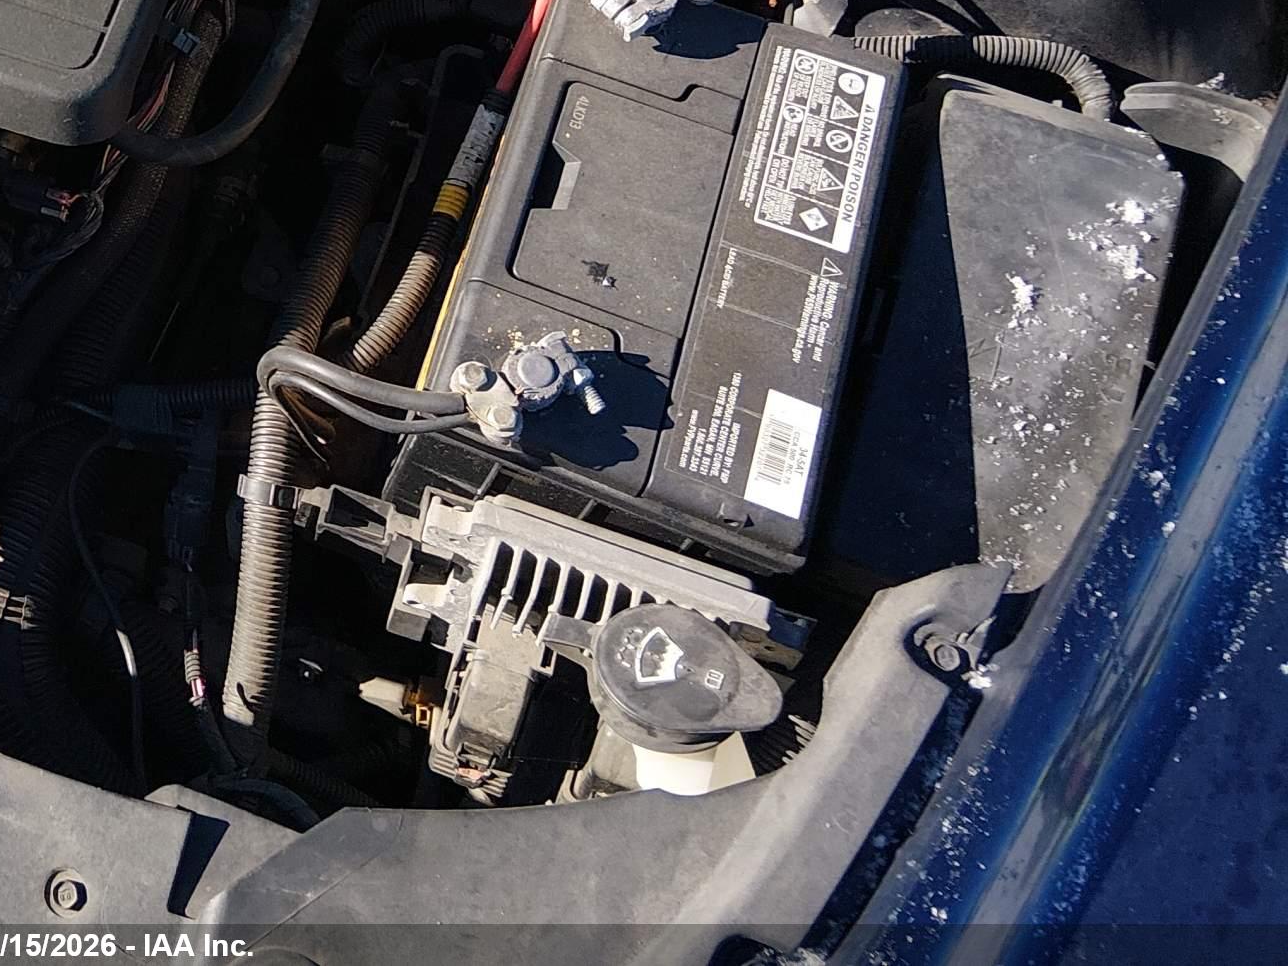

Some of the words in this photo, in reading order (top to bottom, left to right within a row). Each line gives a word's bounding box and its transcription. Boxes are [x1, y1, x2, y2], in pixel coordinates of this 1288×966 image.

[841, 117, 874, 223] DANGER/POISON
[725, 247, 737, 265] LEAD
[721, 264, 733, 280] ACID
[715, 279, 729, 309] BATTERY
[809, 277, 829, 324] Reproductive
[820, 280, 839, 321] WARNING:
[805, 323, 819, 344] Harm
[815, 320, 830, 347] Cancer
[812, 346, 824, 362] and
[715, 385, 727, 405] SUITE
[721, 385, 739, 426] CORPORATE
[705, 417, 720, 443] EAGAN,
[715, 425, 730, 452] CENTER
[725, 422, 741, 456] IMPORTED
[790, 431, 800, 447] CCA
[703, 443, 714, 455] MN
[698, 456, 711, 475] 55121
[722, 455, 733, 468] BY:
